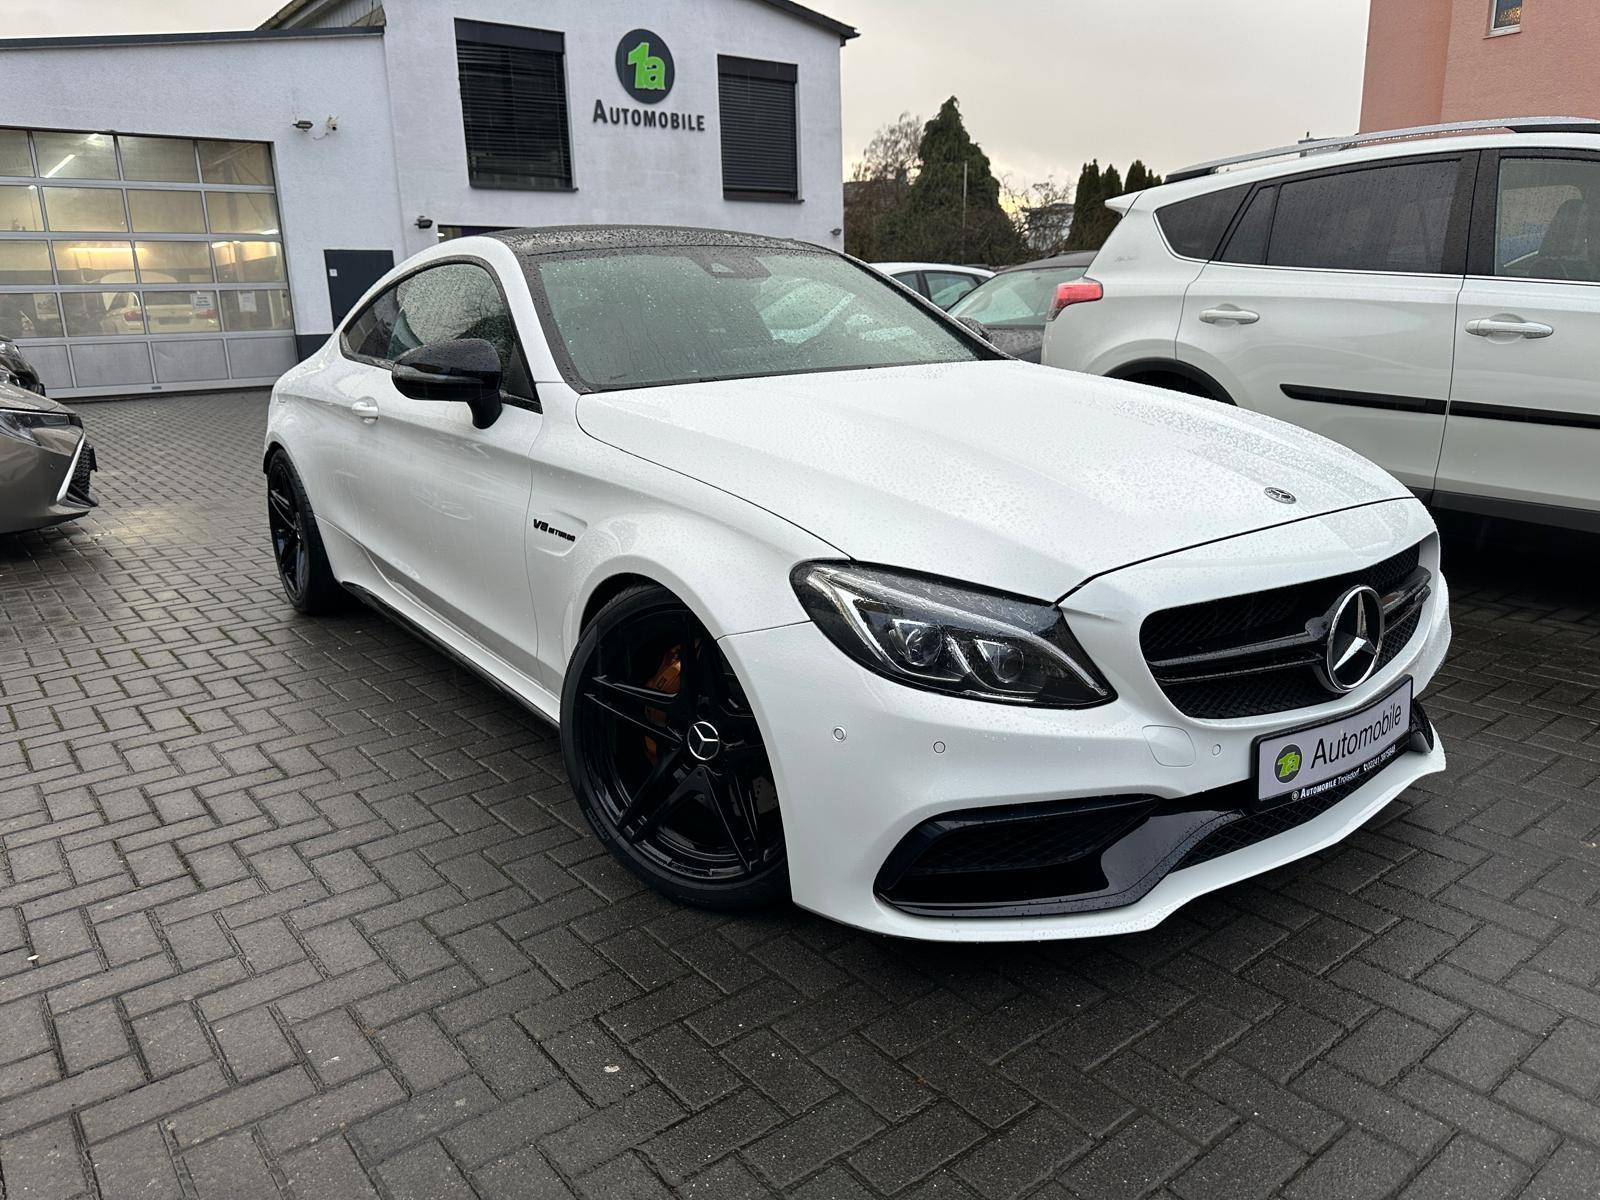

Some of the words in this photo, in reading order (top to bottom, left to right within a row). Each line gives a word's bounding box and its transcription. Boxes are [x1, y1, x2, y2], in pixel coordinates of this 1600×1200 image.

[627, 42, 665, 90] 1a
[593, 99, 705, 132] AUTOMOBILE
[533, 519, 549, 532] V8
[1310, 703, 1402, 769] Automobile
